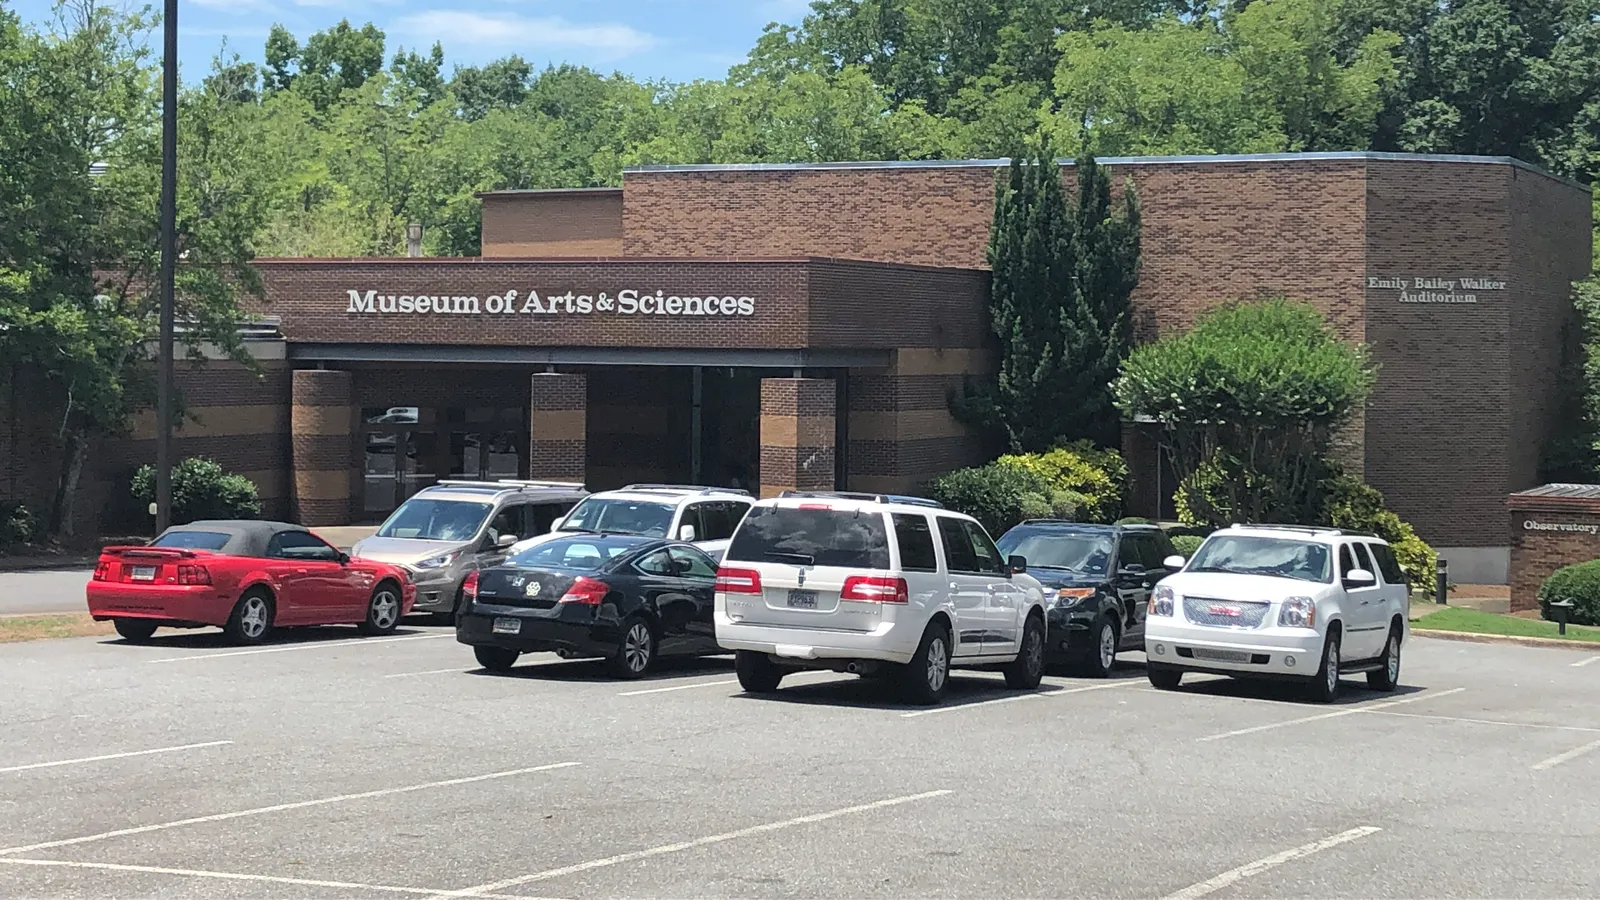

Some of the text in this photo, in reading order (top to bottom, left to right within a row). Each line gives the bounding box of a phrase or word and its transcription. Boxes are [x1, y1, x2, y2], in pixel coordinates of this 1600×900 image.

[1367, 277, 1506, 291] Emily Bailey Walker
[346, 290, 481, 314] Museum
[485, 289, 518, 314] of
[1399, 291, 1477, 303] Auditorium
[1523, 520, 1599, 534] Observatory
